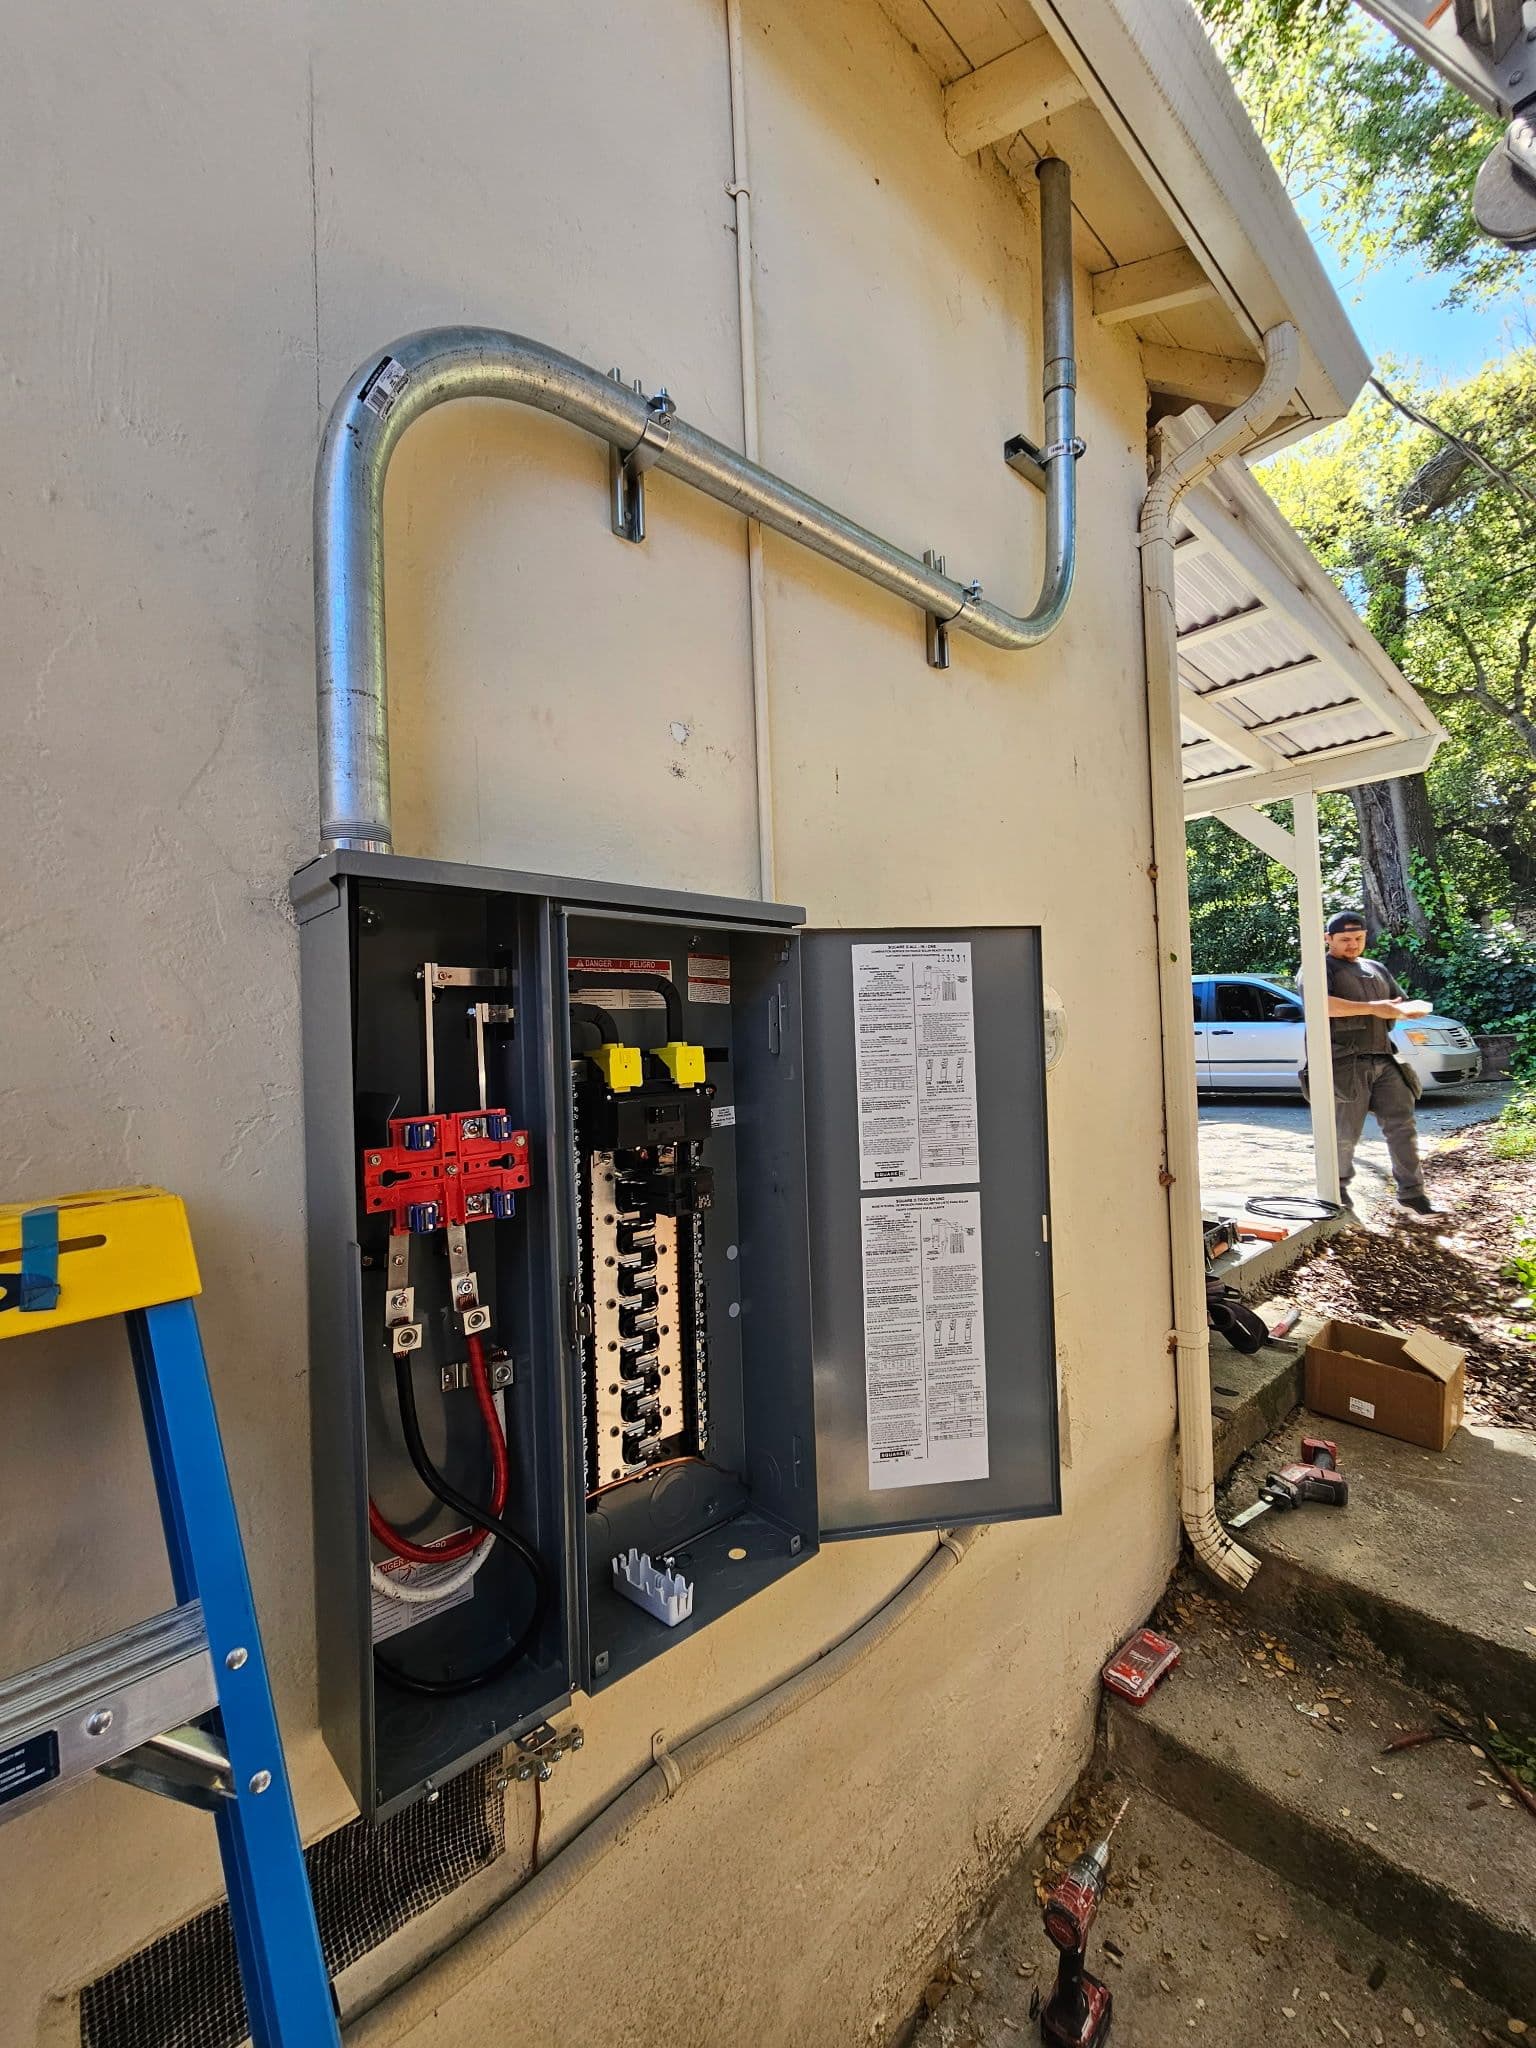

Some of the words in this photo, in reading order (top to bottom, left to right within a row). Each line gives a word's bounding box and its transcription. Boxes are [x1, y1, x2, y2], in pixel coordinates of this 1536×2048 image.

[585, 959, 613, 968] DANGER
[629, 960, 656, 969] PELIGRO
[381, 1558, 405, 1572] NGER
